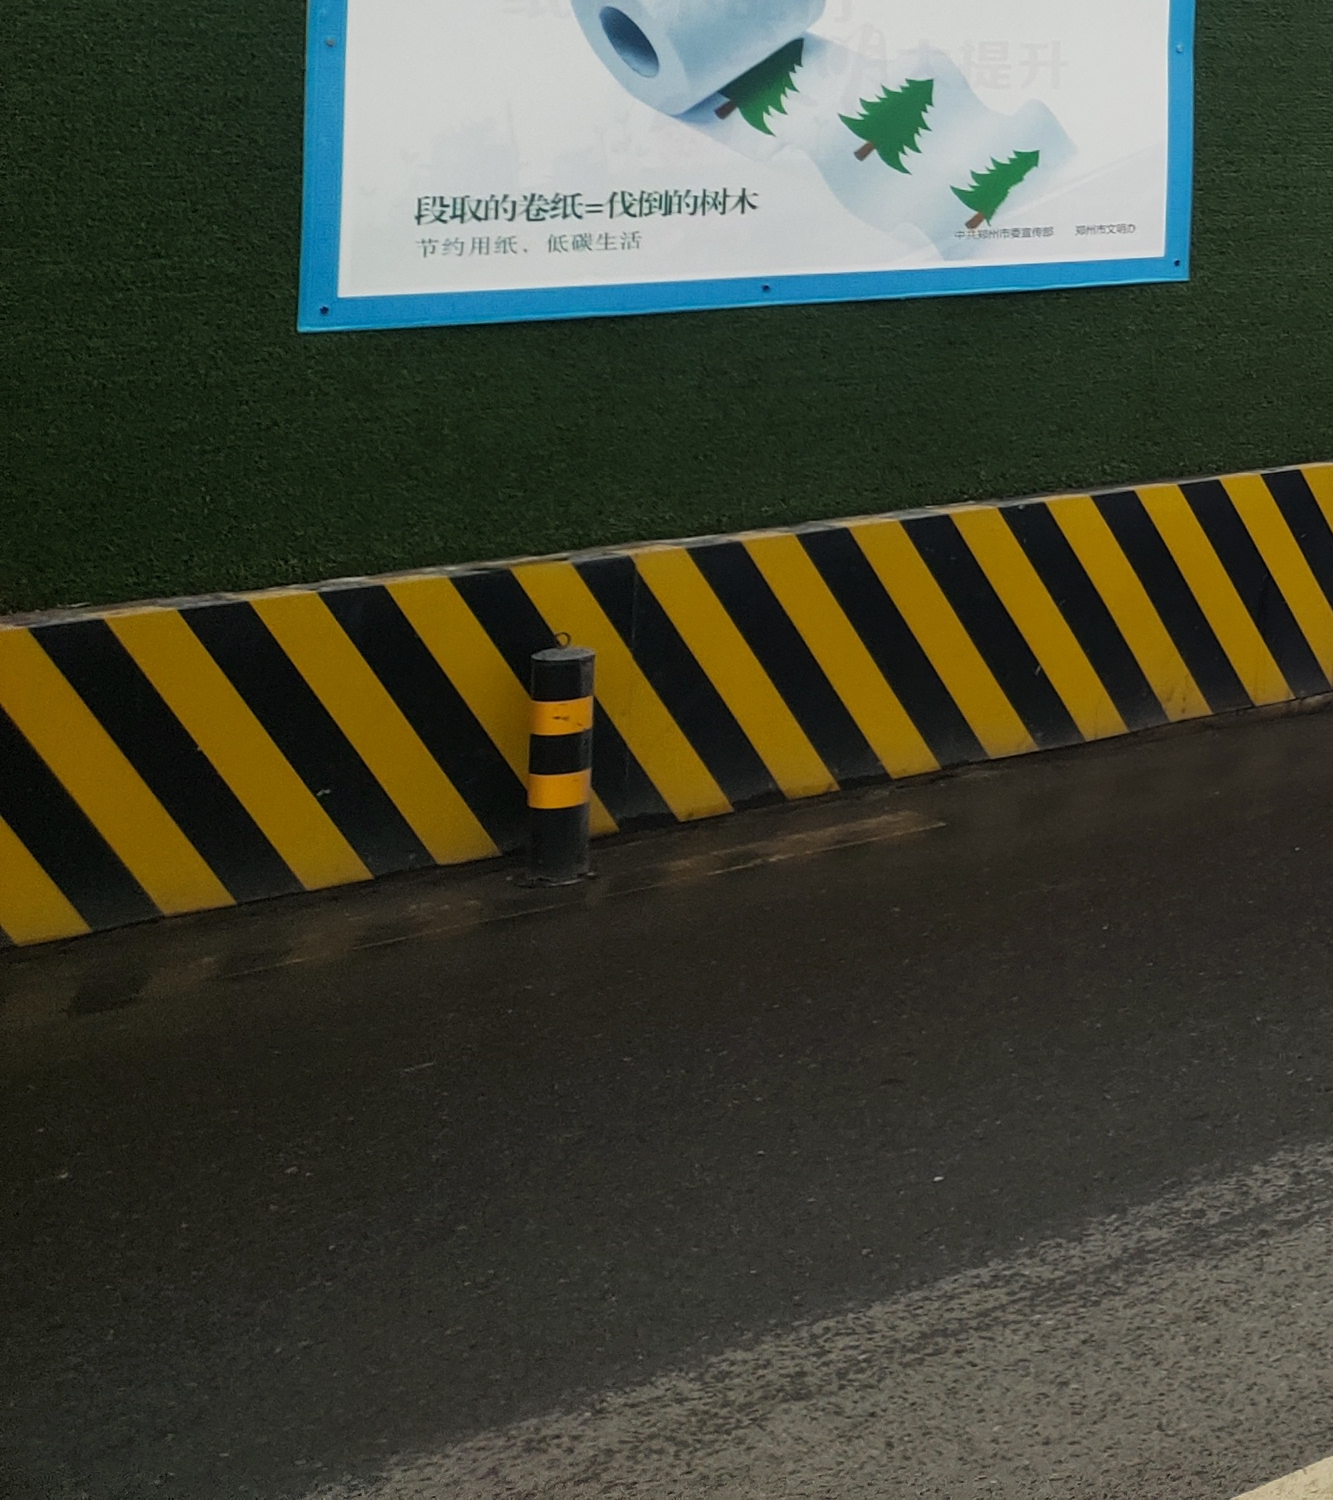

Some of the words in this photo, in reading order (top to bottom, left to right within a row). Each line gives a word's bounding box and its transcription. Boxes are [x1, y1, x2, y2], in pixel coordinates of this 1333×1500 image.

[415, 188, 759, 225] 段取的卷纸=伐倒的树木
[955, 226, 1054, 240] 中共郑州市委宣传部
[1075, 224, 1136, 237] 郑州市文明办
